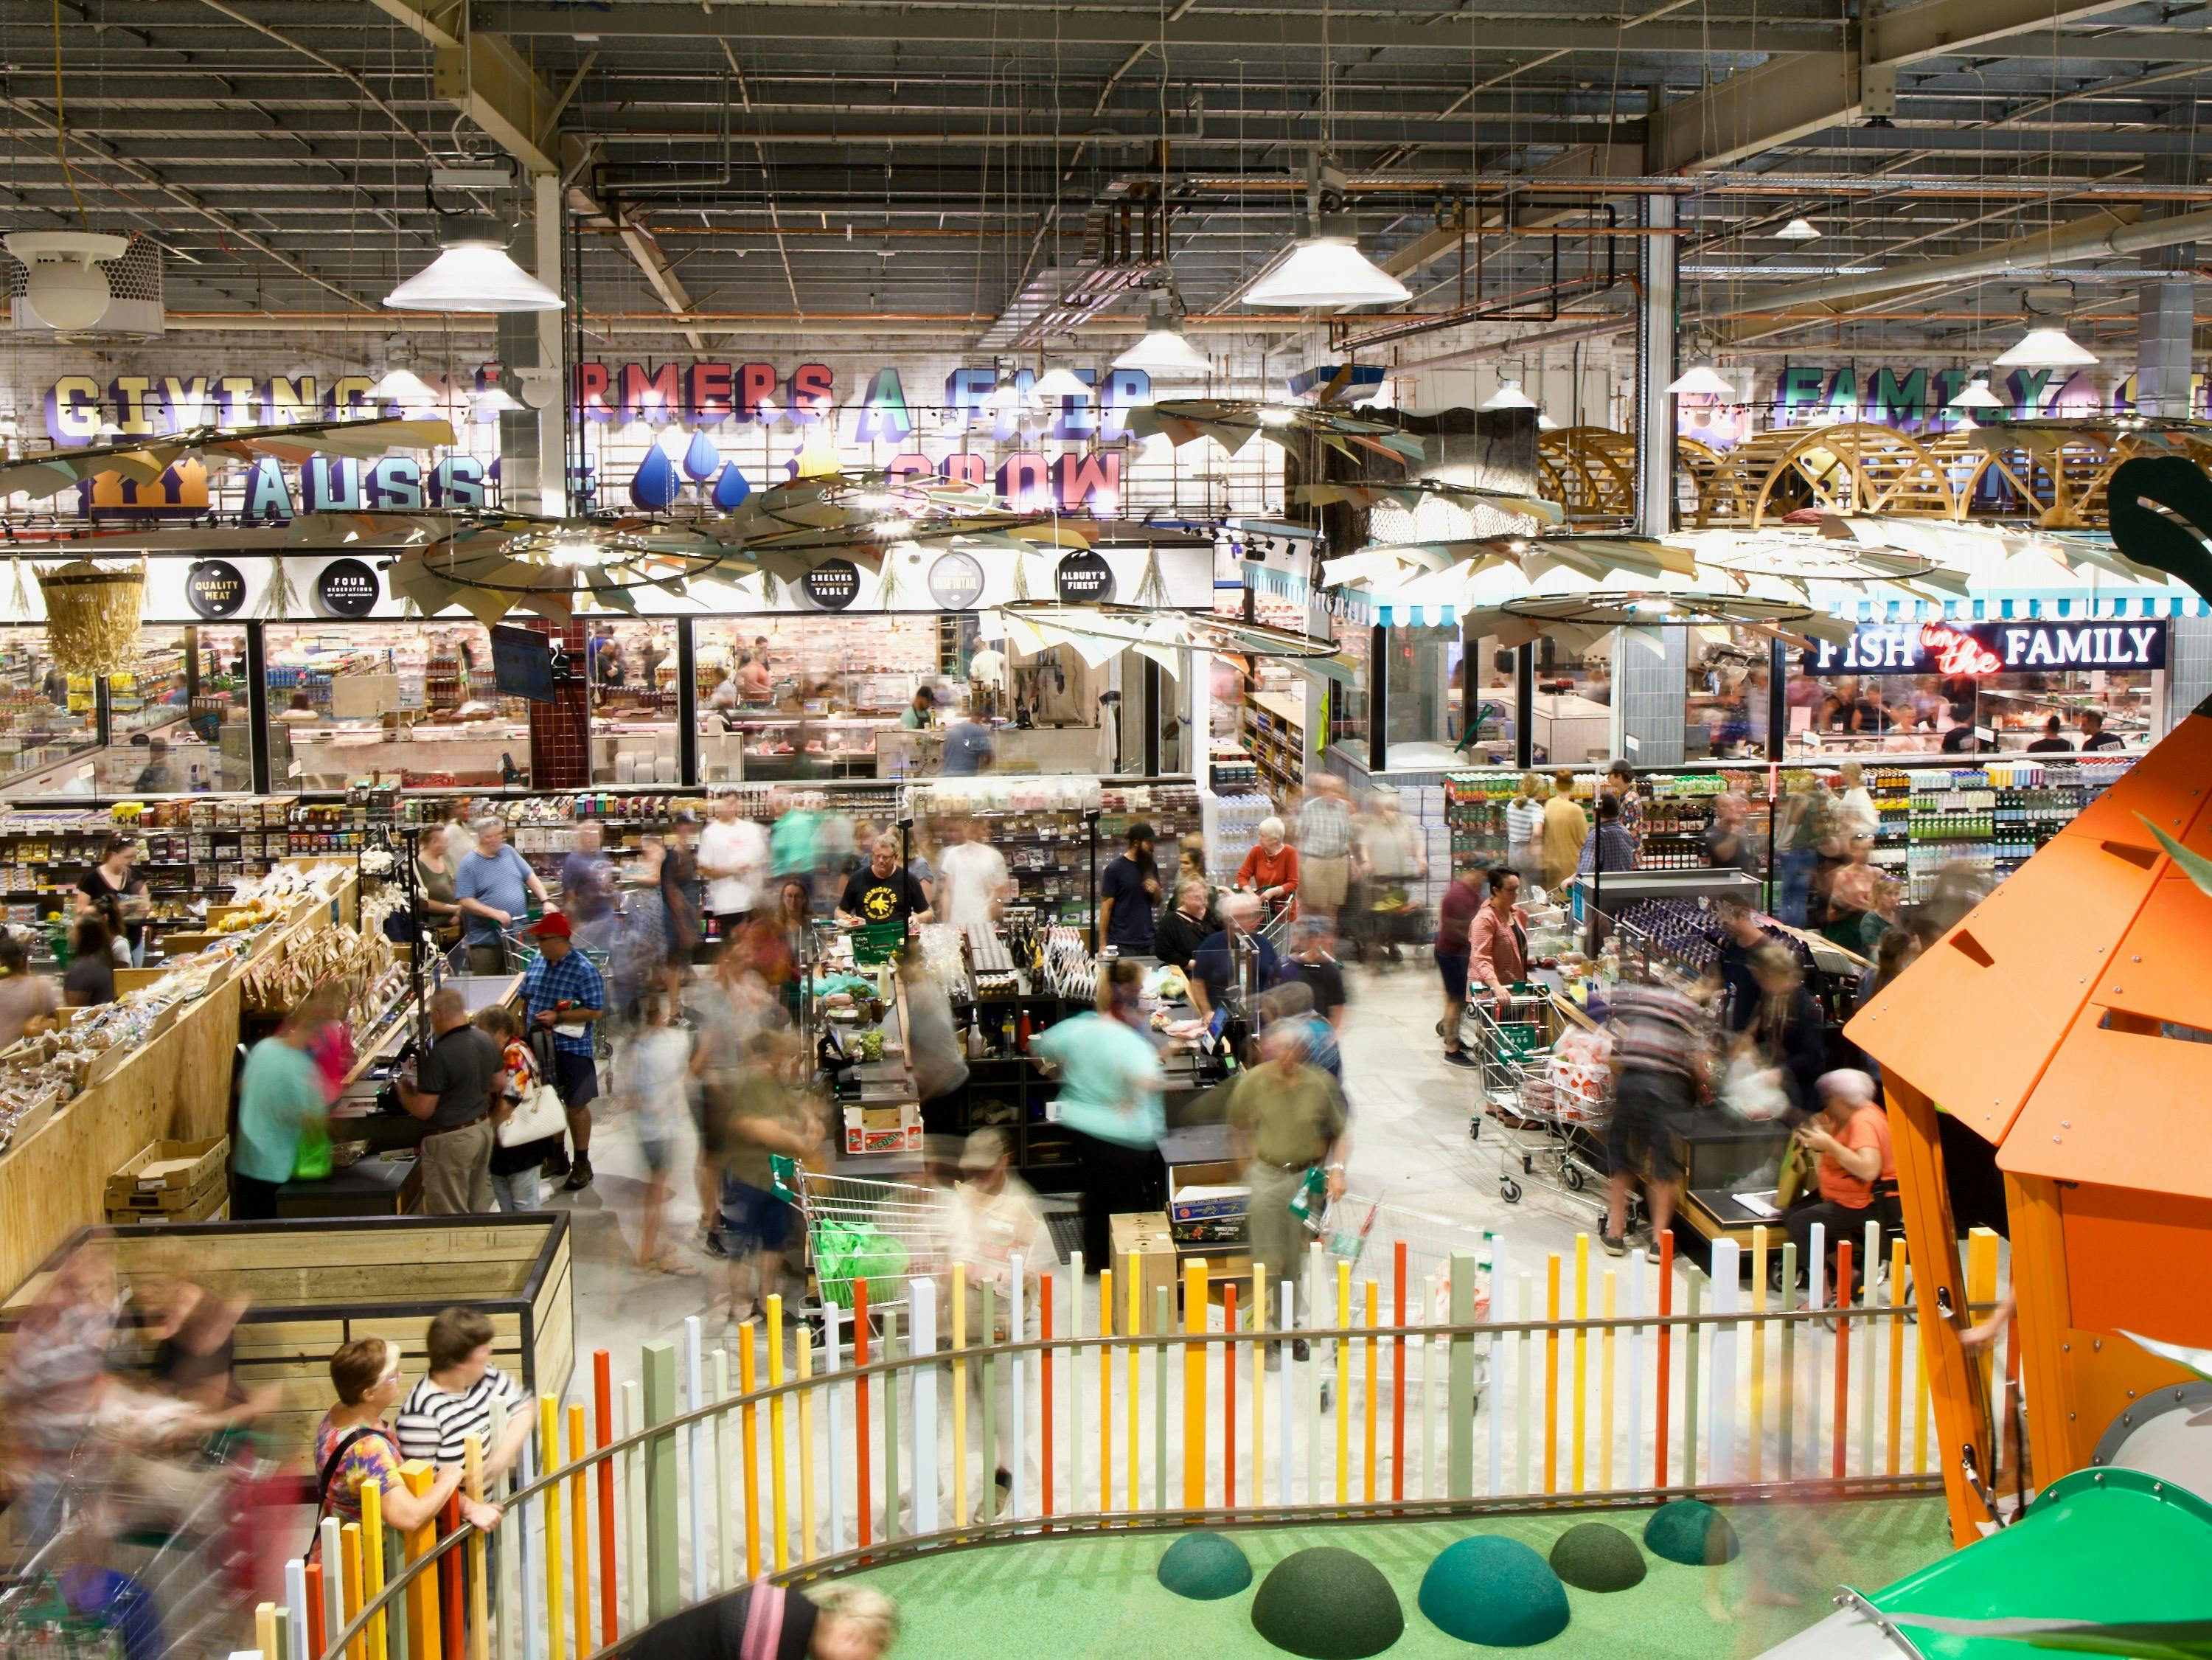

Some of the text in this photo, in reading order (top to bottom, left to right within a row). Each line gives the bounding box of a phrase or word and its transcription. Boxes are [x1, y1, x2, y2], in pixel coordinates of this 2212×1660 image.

[45, 375, 379, 442] GIVING
[476, 362, 834, 424] RMERS
[855, 367, 912, 442] A
[1774, 367, 2053, 431] FAMILY
[810, 574, 852, 582] SHELVES
[1061, 571, 1106, 580] ALBURY'S
[195, 580, 238, 591] QUALITY
[334, 577, 365, 586] FOUR
[1067, 581, 1099, 590] FINEST
[204, 591, 231, 600] MEAT
[815, 587, 849, 596] TABLE
[1817, 621, 2157, 674] FISH in the FAMILY
[863, 886, 897, 904] MIDNIGHT OIL
